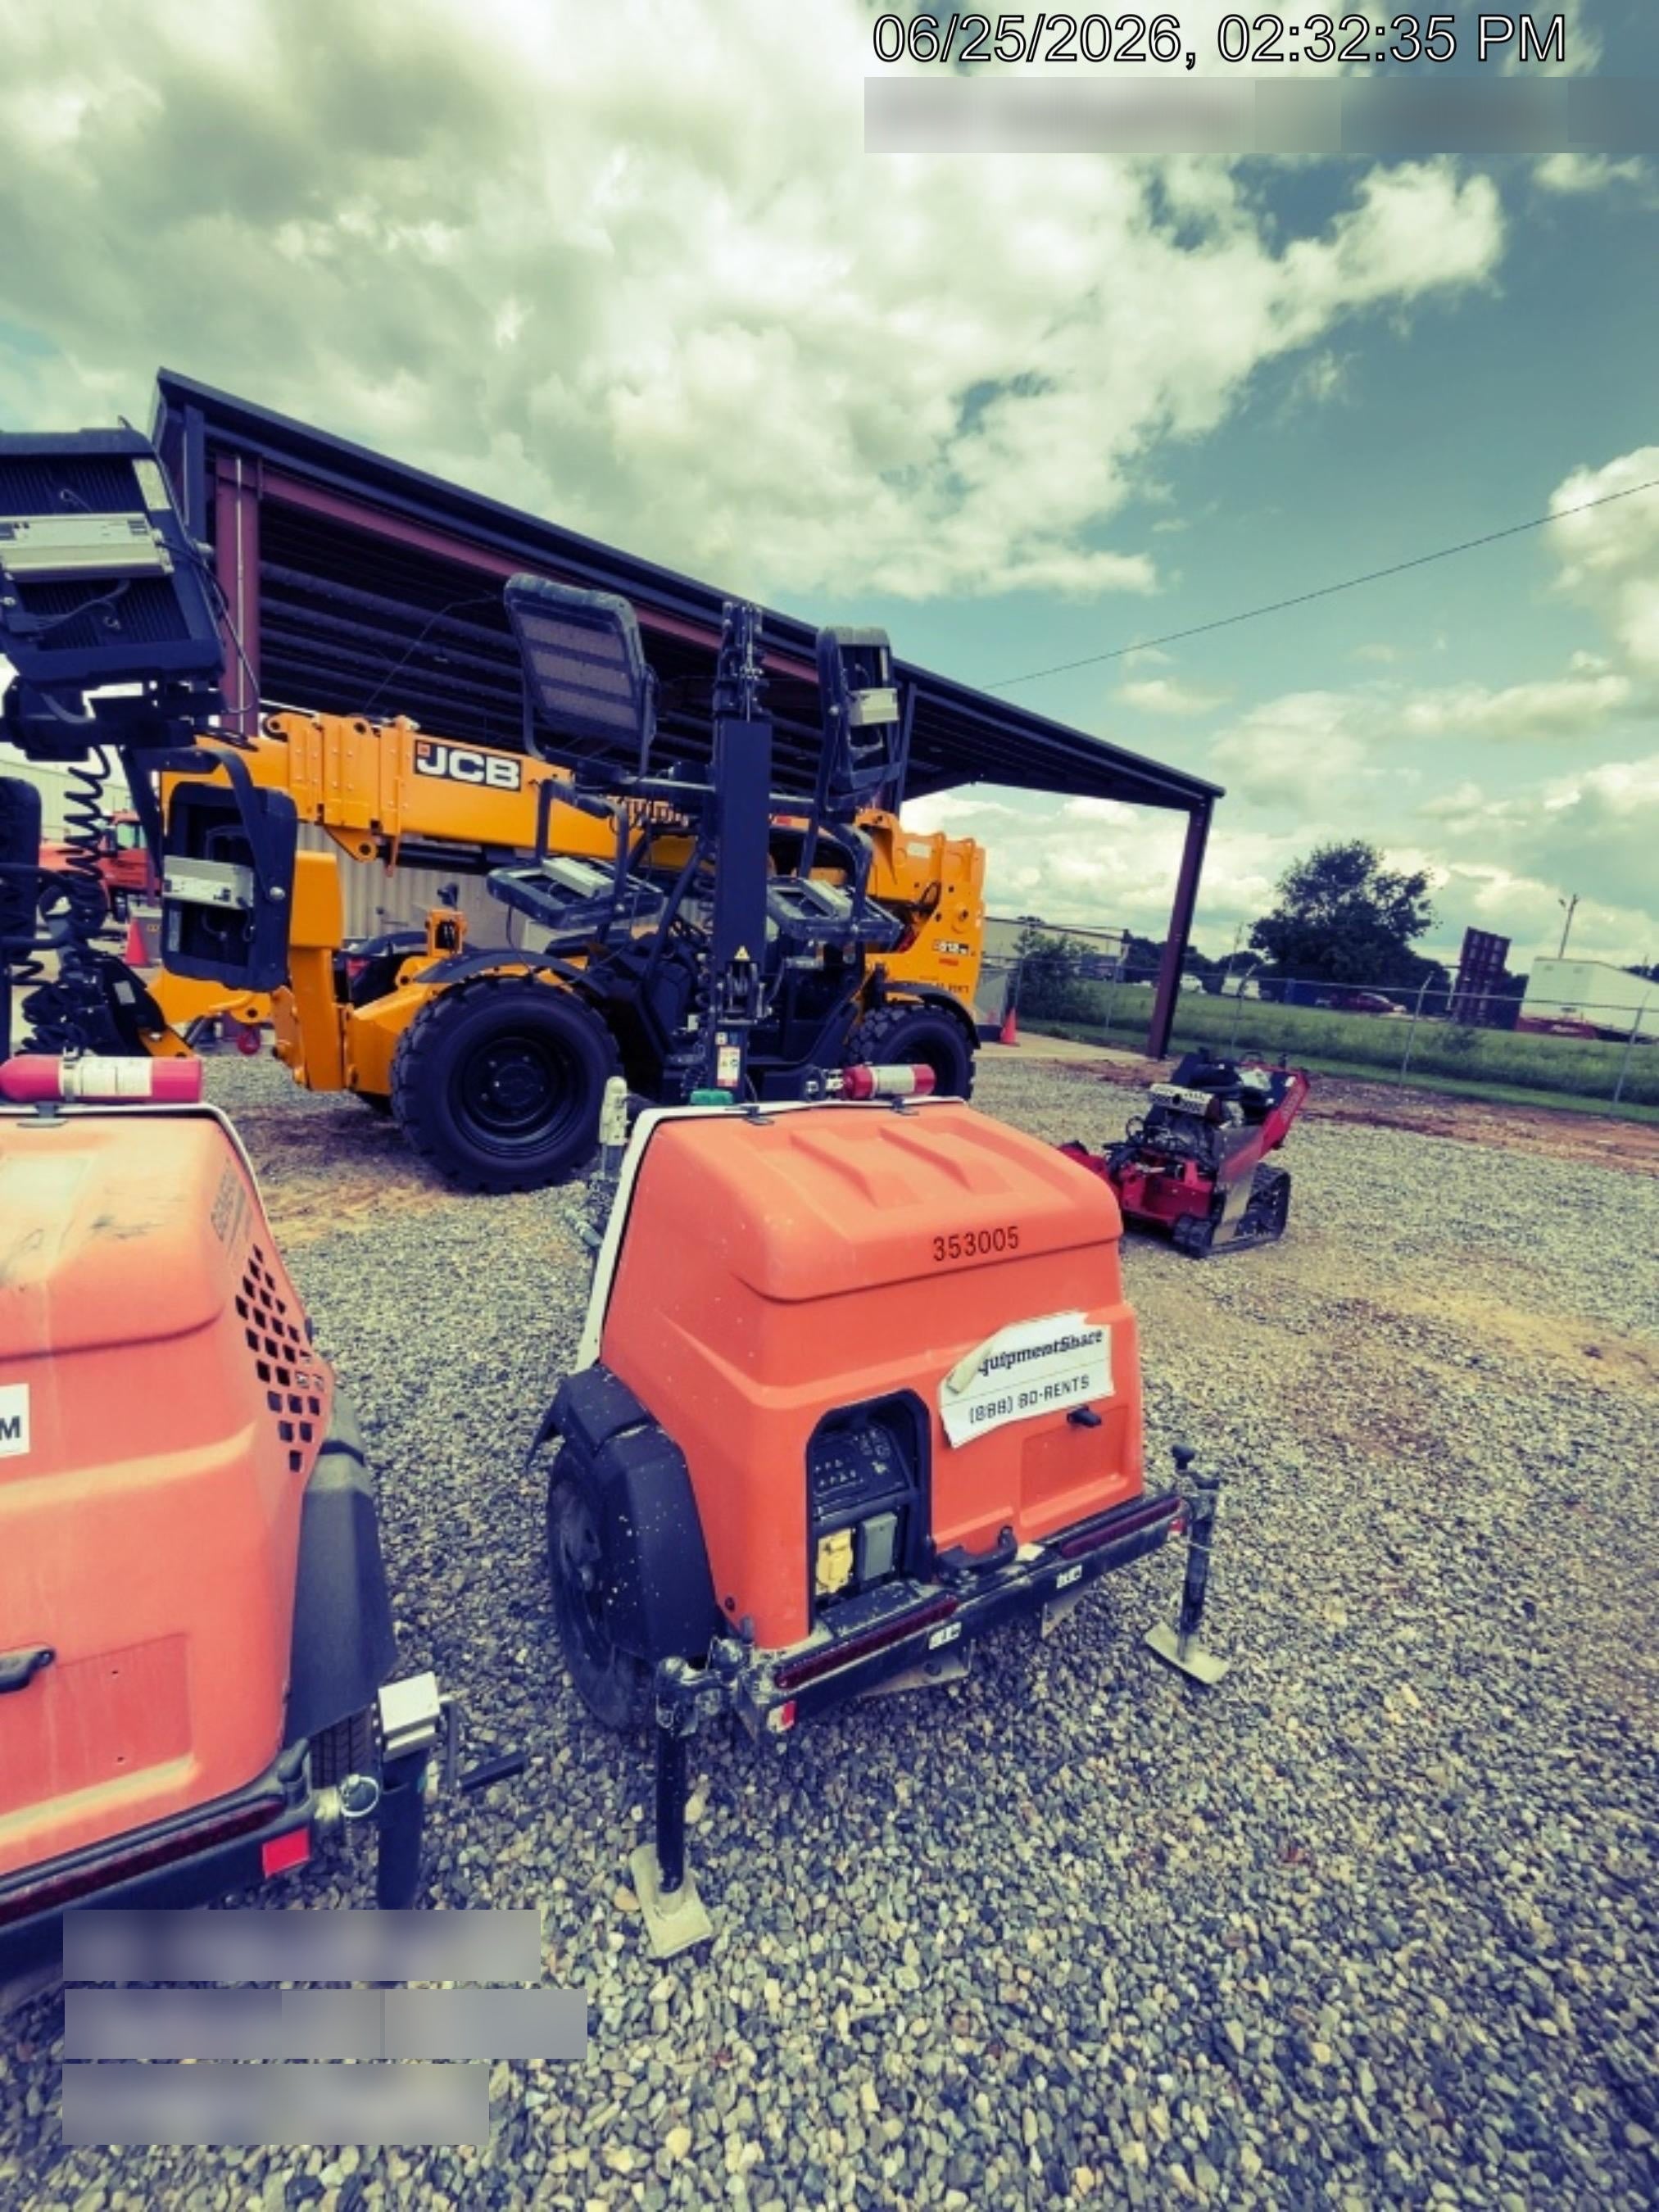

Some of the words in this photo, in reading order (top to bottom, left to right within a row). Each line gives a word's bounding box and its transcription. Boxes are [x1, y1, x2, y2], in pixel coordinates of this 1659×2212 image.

[416, 744, 520, 790] JCB
[932, 1226, 1020, 1262] 353005
[978, 1329, 1104, 1377] quipmentShare
[969, 1395, 1014, 1424] (888)
[1018, 1374, 1090, 1410] 80-RENTS
